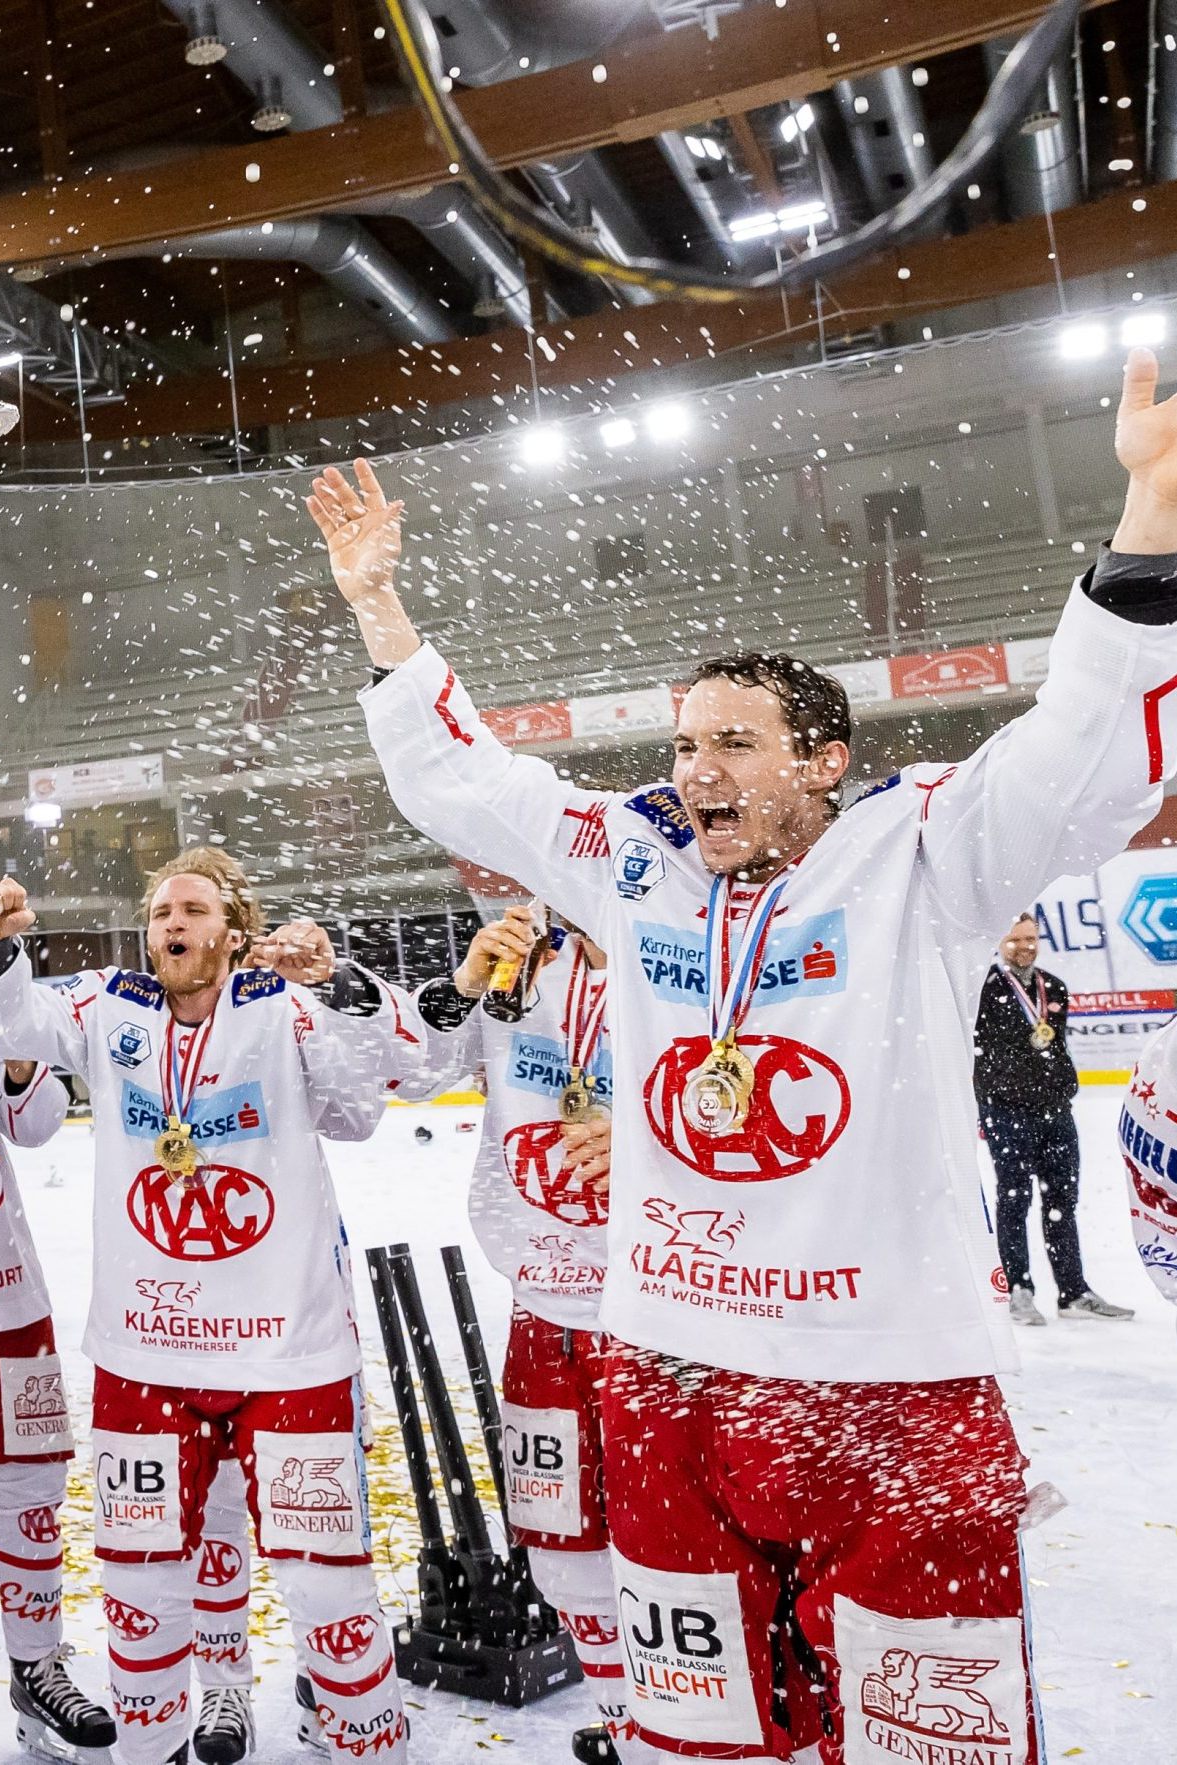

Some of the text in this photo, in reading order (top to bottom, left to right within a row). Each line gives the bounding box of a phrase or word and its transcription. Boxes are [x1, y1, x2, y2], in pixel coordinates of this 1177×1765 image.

[127, 1164, 274, 1262] KAC
[517, 1264, 607, 1284] KLAGEN
[640, 1281, 784, 1319] AM WÖRTHERSEE
[125, 1309, 285, 1338] KLAGENFURT
[140, 1336, 167, 1348] AM
[513, 1432, 563, 1470] JB
[107, 1458, 165, 1493] JB
[518, 1477, 564, 1500] LICHT
[115, 1503, 166, 1520] LICHT
[273, 1513, 353, 1533] GENERALI
[199, 1632, 242, 1645] AUTO
[631, 1602, 723, 1659] JB
[635, 1650, 669, 1667] JAEGER
[676, 1657, 727, 1674] BLASSNIG
[649, 1666, 728, 1700] LICHT
[653, 1691, 680, 1704] GMBH
[348, 1708, 394, 1736] AUTO
